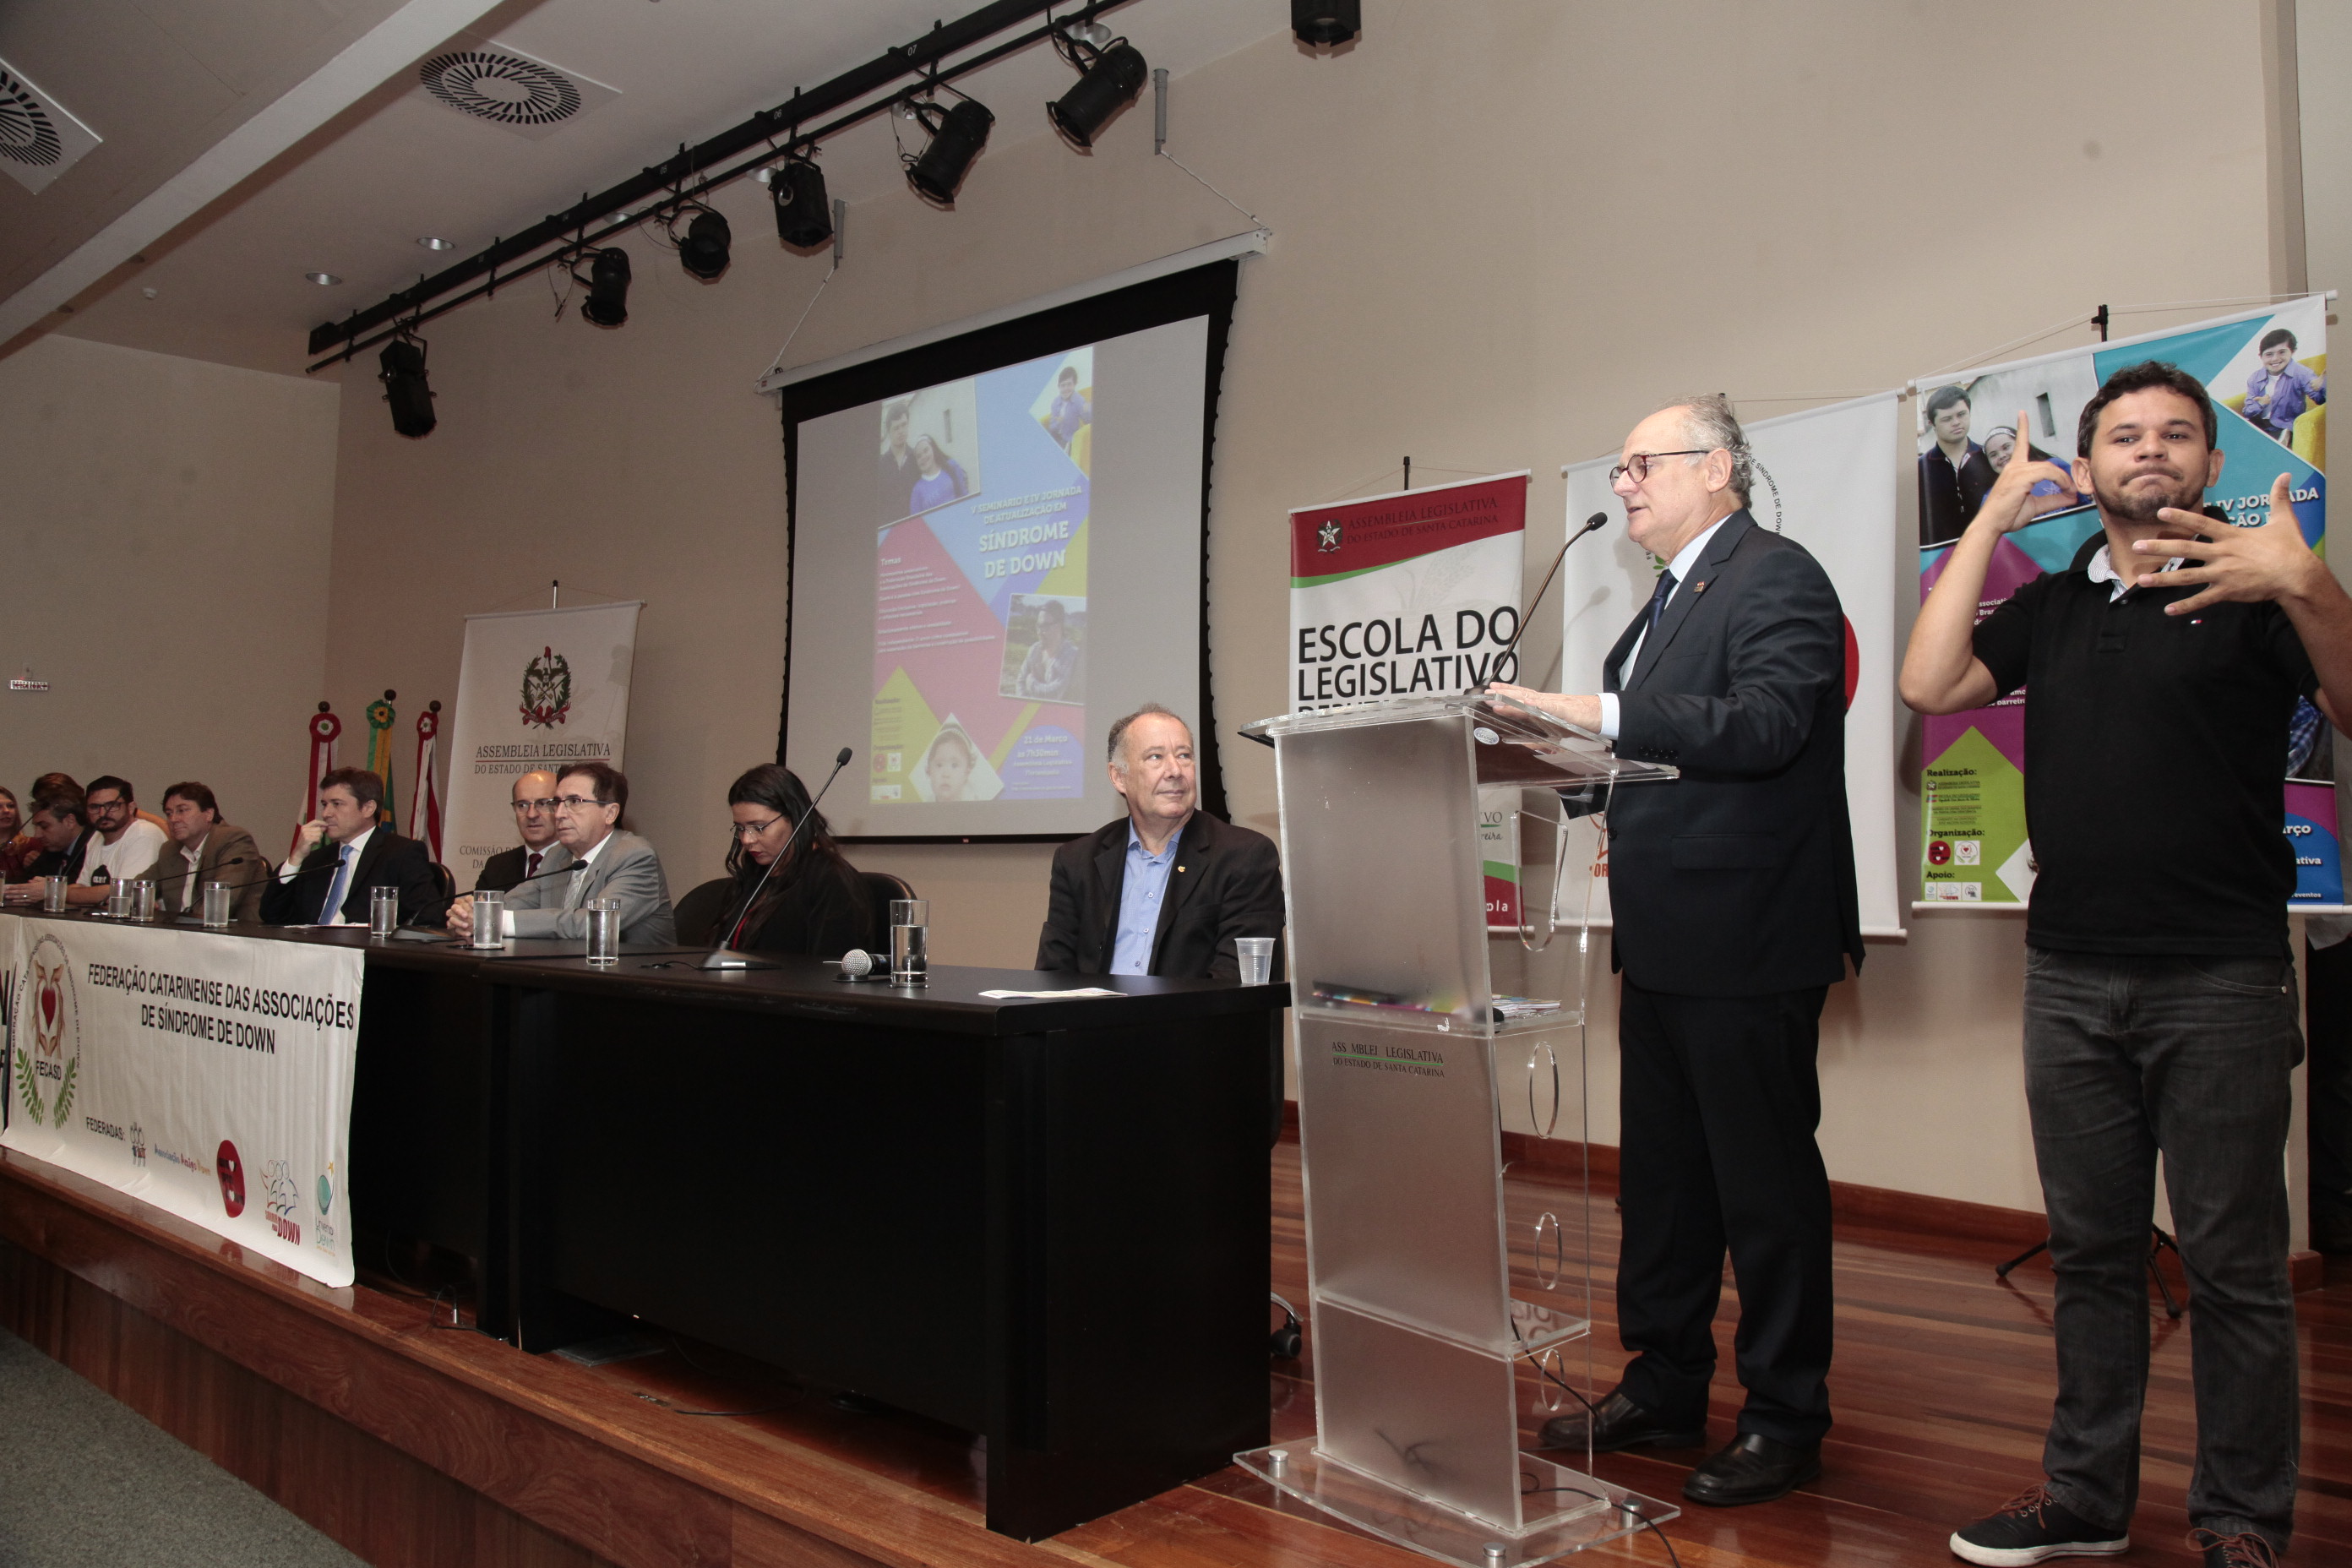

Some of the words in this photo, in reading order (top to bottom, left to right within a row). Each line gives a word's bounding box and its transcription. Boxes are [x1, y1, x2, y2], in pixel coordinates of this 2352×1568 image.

[1042, 486, 1082, 500] JORNADA
[1755, 463, 1779, 498] SÍNDROME
[1774, 498, 1782, 509] DE
[984, 515, 994, 524] DE
[1054, 502, 1067, 511] EM
[1348, 511, 1417, 531] ASSEMBLEIA
[1421, 497, 1498, 518] LEGISLATIVA
[979, 520, 1069, 553] SÍNDROME
[1347, 535, 1361, 544] DO
[1364, 530, 1399, 542] ESTADO
[1402, 526, 1414, 536] DE
[1416, 521, 1446, 535] SANTA
[1448, 514, 1499, 529] CATARINA
[984, 558, 1005, 579] DE
[1010, 549, 1066, 574] DOWN
[1298, 613, 1442, 664] ESCOLA
[1456, 606, 1520, 650] DO
[1298, 651, 1519, 700] LEGISLATIVO
[476, 744, 540, 758] ASSEMBLEIA
[542, 743, 611, 757] LEGISLATIVA
[475, 765, 486, 774] DO
[488, 764, 521, 774] ESTADO
[523, 764, 535, 774] DE
[537, 764, 558, 774] SANT
[1926, 769, 1977, 777] Realização:
[460, 845, 503, 856] COMISSÃO
[472, 859, 484, 868] DA
[1926, 871, 1955, 879] Apoio:
[88, 963, 147, 995] FEDERAÇÃO
[149, 972, 223, 1006] CATARINENSE
[226, 983, 250, 1012] DAS
[253, 988, 354, 1031] ASSOCIAÇÕES
[141, 1004, 155, 1028] DE
[158, 1002, 215, 1041] SÍNDROME
[217, 1018, 233, 1045] DE
[236, 1022, 275, 1054] DOWN
[1386, 1047, 1444, 1064] LEGISLATIVA
[35, 1060, 62, 1081] FECASD
[1345, 1059, 1371, 1069] ESTADO
[1373, 1061, 1383, 1070] DE
[1385, 1063, 1407, 1073] SANTA
[1408, 1066, 1445, 1078] CATARINA
[86, 1117, 126, 1141] FEDERADAS:
[277, 1217, 301, 1246] DOWN
